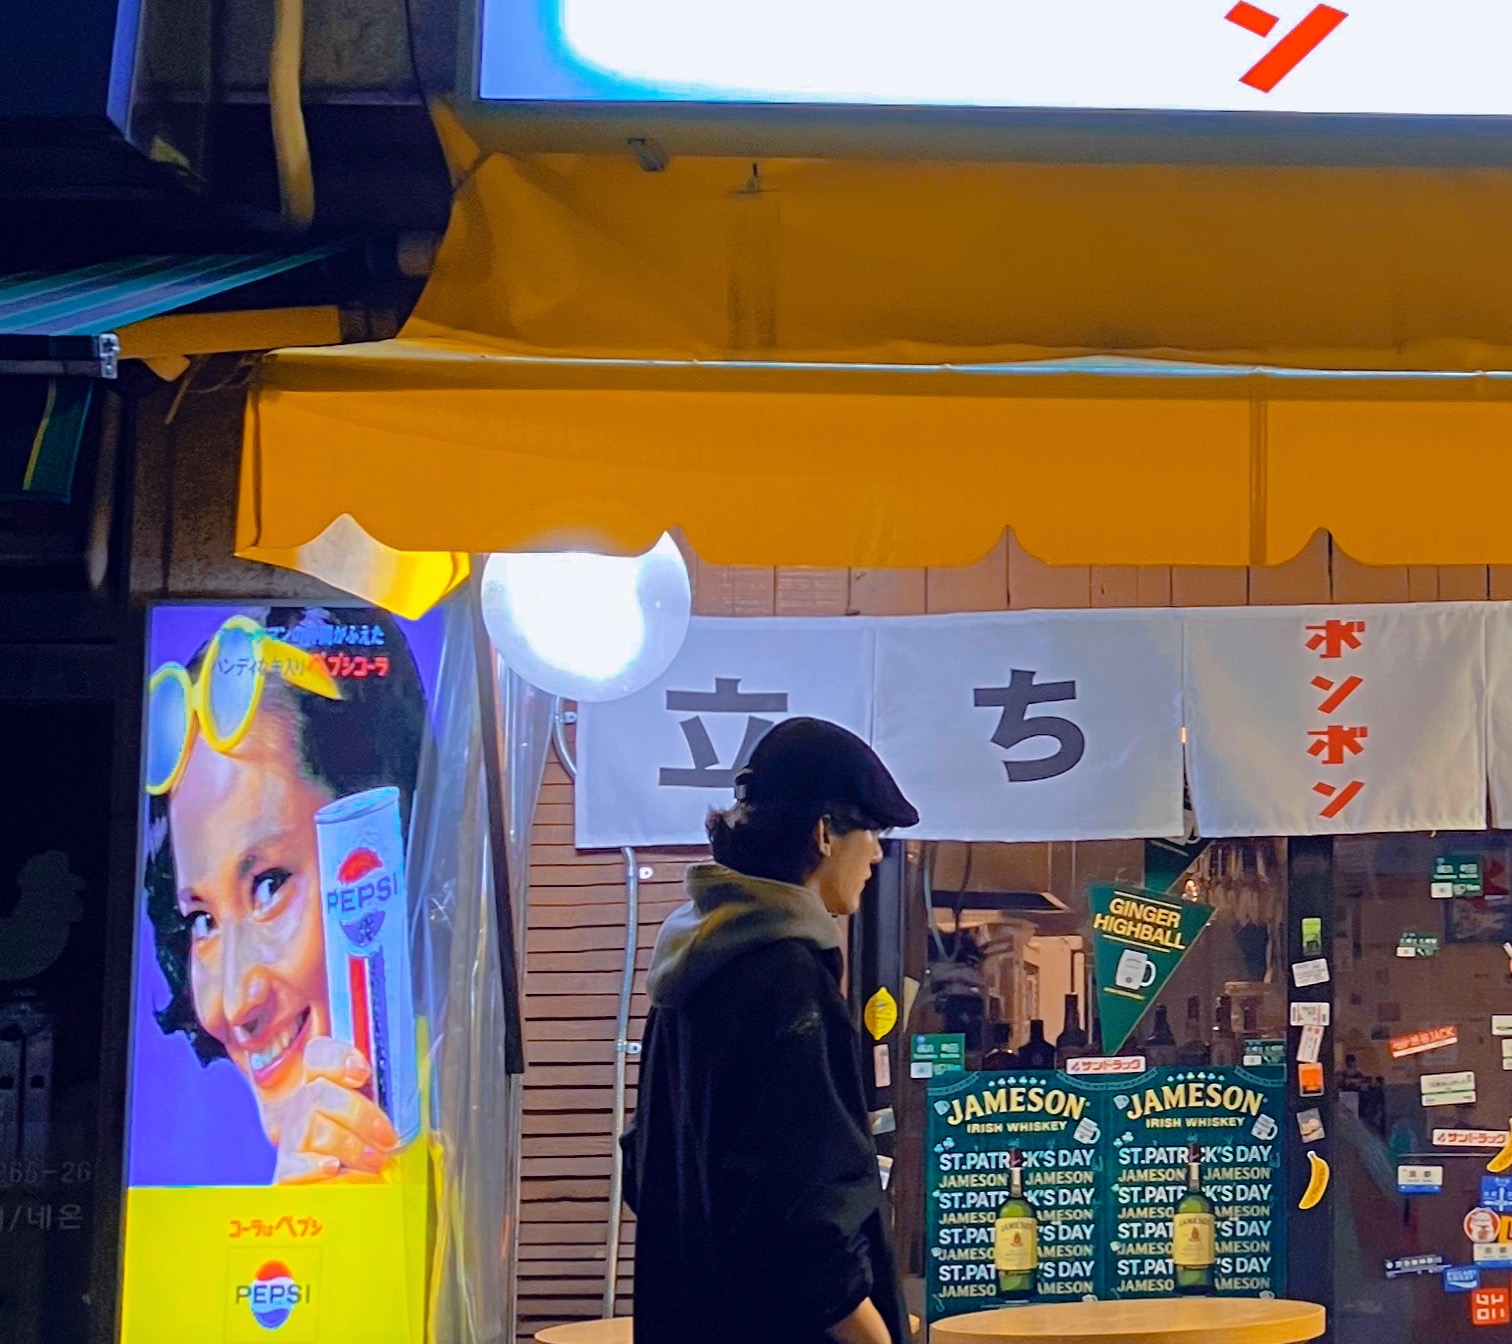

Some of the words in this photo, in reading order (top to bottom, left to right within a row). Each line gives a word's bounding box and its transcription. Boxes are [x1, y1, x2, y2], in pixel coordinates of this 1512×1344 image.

[1305, 618, 1365, 821] ボンボン
[327, 872, 399, 915] PEPSI
[1109, 897, 1182, 928] GINGER
[1093, 913, 1186, 950] HIGHBALL
[948, 1086, 1086, 1126] JAMESON
[1126, 1083, 1263, 1120] JAMESON
[967, 1122, 1002, 1134] IRISH
[1007, 1120, 1068, 1133] WHISKEY
[1146, 1118, 1182, 1129] IRISH
[1186, 1117, 1245, 1129] WHISKEY
[1058, 1149, 1095, 1167] DAY
[1236, 1145, 1272, 1163] DAY
[939, 1173, 1008, 1188] JAMESON
[1025, 1171, 1093, 1185] JAMESON
[1118, 1168, 1186, 1182] JAMESON
[1203, 1167, 1270, 1180] JAMESON
[1058, 1188, 1095, 1206] DAY
[1235, 1184, 1272, 1202] DAY
[939, 1212, 996, 1225] JAMESO
[1036, 1209, 1093, 1221] AMESON
[1118, 1207, 1174, 1219] JAMESO
[1214, 1205, 1270, 1217] AMESON
[228, 1215, 323, 1238] コーラはペプシ
[1058, 1224, 1095, 1241] DAY
[1235, 1220, 1272, 1237] DAY
[938, 1248, 995, 1261] JAMESO
[1037, 1245, 1093, 1257] AMESON
[1117, 1242, 1173, 1255] JAMESO
[1214, 1241, 1270, 1253] AMESON
[1058, 1261, 1095, 1278] DAY
[1235, 1257, 1271, 1274] DAY
[939, 1284, 996, 1298] JAMESO
[1037, 1281, 1093, 1294] AMESON
[1117, 1279, 1174, 1292] JAMESO
[1215, 1277, 1270, 1290] AMESON
[235, 1284, 311, 1305] PEPSI
